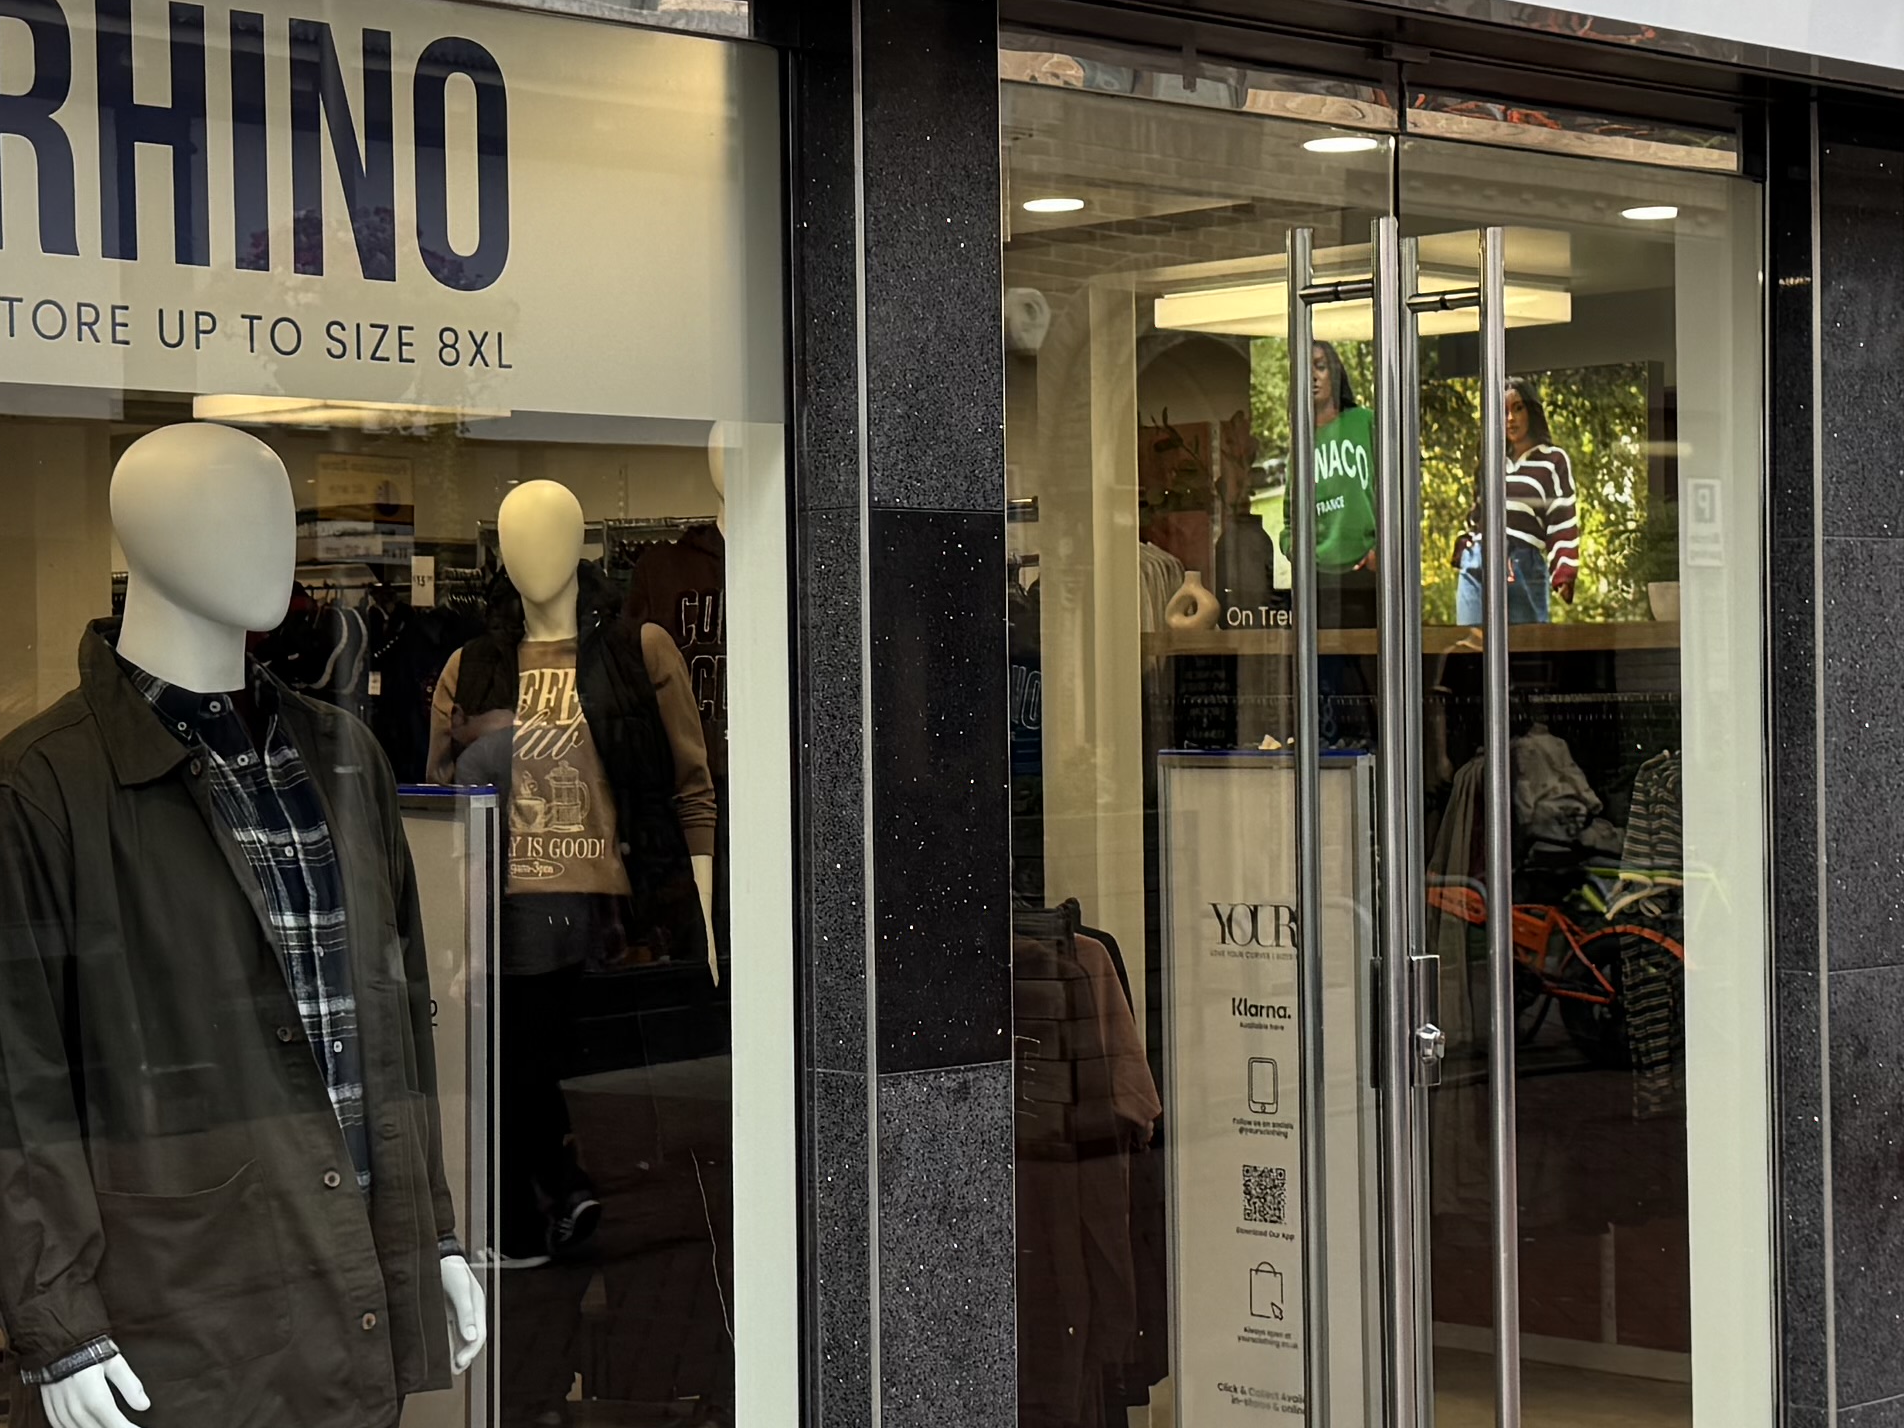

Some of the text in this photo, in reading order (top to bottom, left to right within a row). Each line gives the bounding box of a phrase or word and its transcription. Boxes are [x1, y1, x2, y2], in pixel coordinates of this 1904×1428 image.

[158, 308, 218, 350] UP
[240, 314, 302, 357] TO
[324, 320, 416, 364] SIZE
[437, 326, 513, 369] 8XL
[1315, 495, 1345, 517] FRANCE
[1226, 606, 1253, 627] On
[527, 837, 544, 859] IS
[549, 837, 606, 860] GOOD!
[1208, 902, 1298, 948] YOUR
[1232, 997, 1292, 1020] Klarna.
[1217, 1382, 1238, 1395] Click
